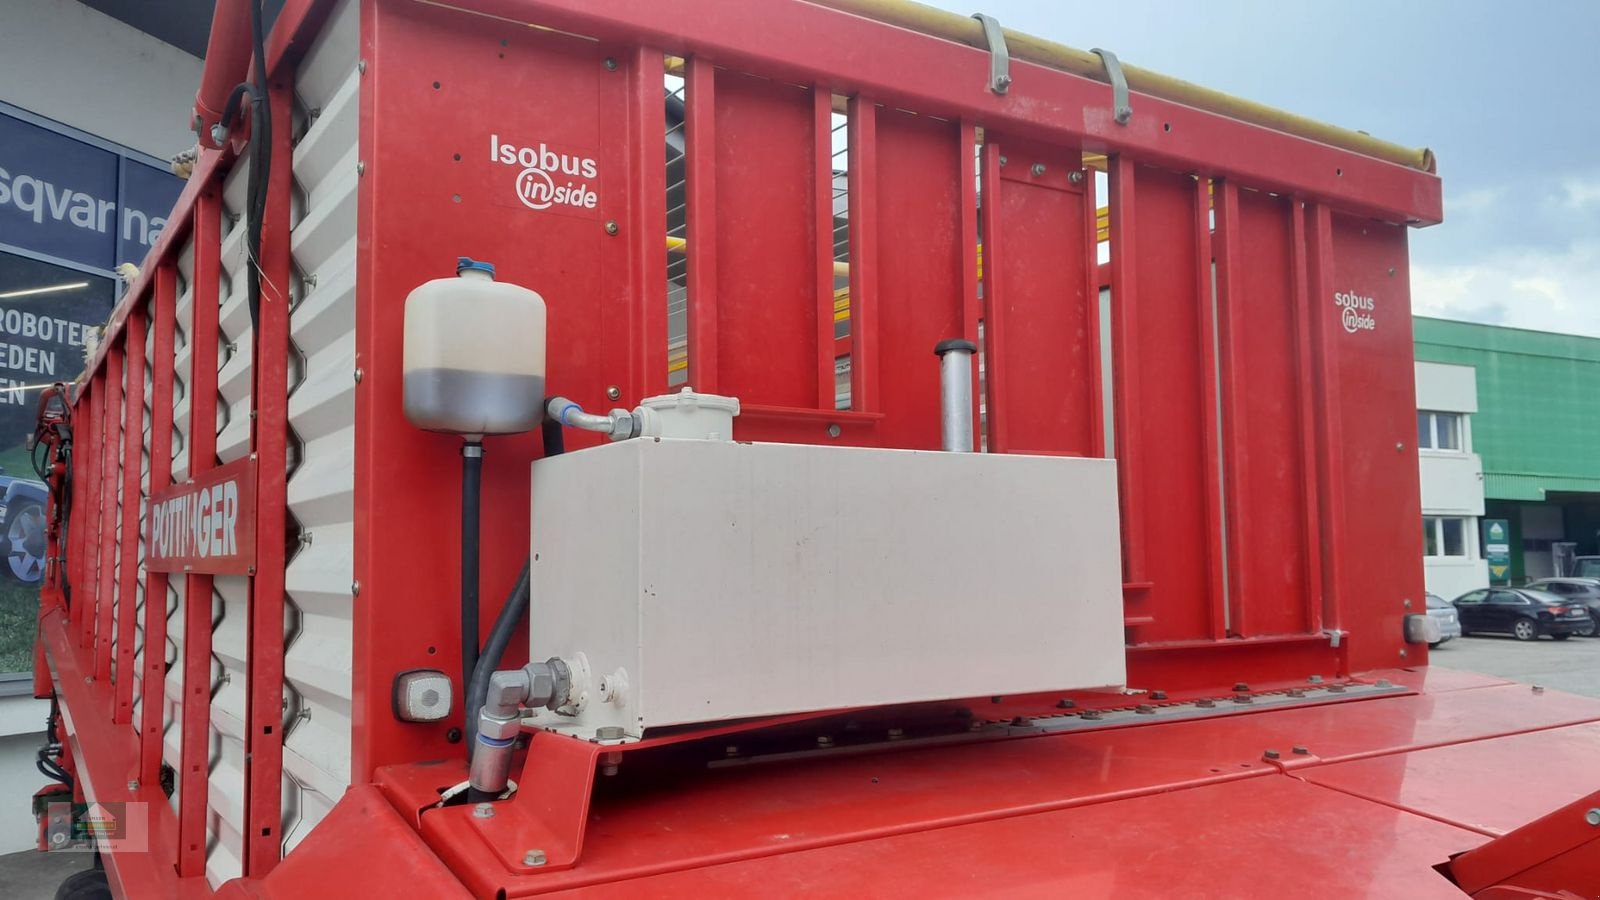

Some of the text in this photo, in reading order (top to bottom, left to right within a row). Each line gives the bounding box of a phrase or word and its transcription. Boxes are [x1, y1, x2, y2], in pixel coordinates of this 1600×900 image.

[490, 133, 597, 179] Isobus
[1334, 289, 1375, 311] sobus
[0, 307, 93, 347] OBOTE
